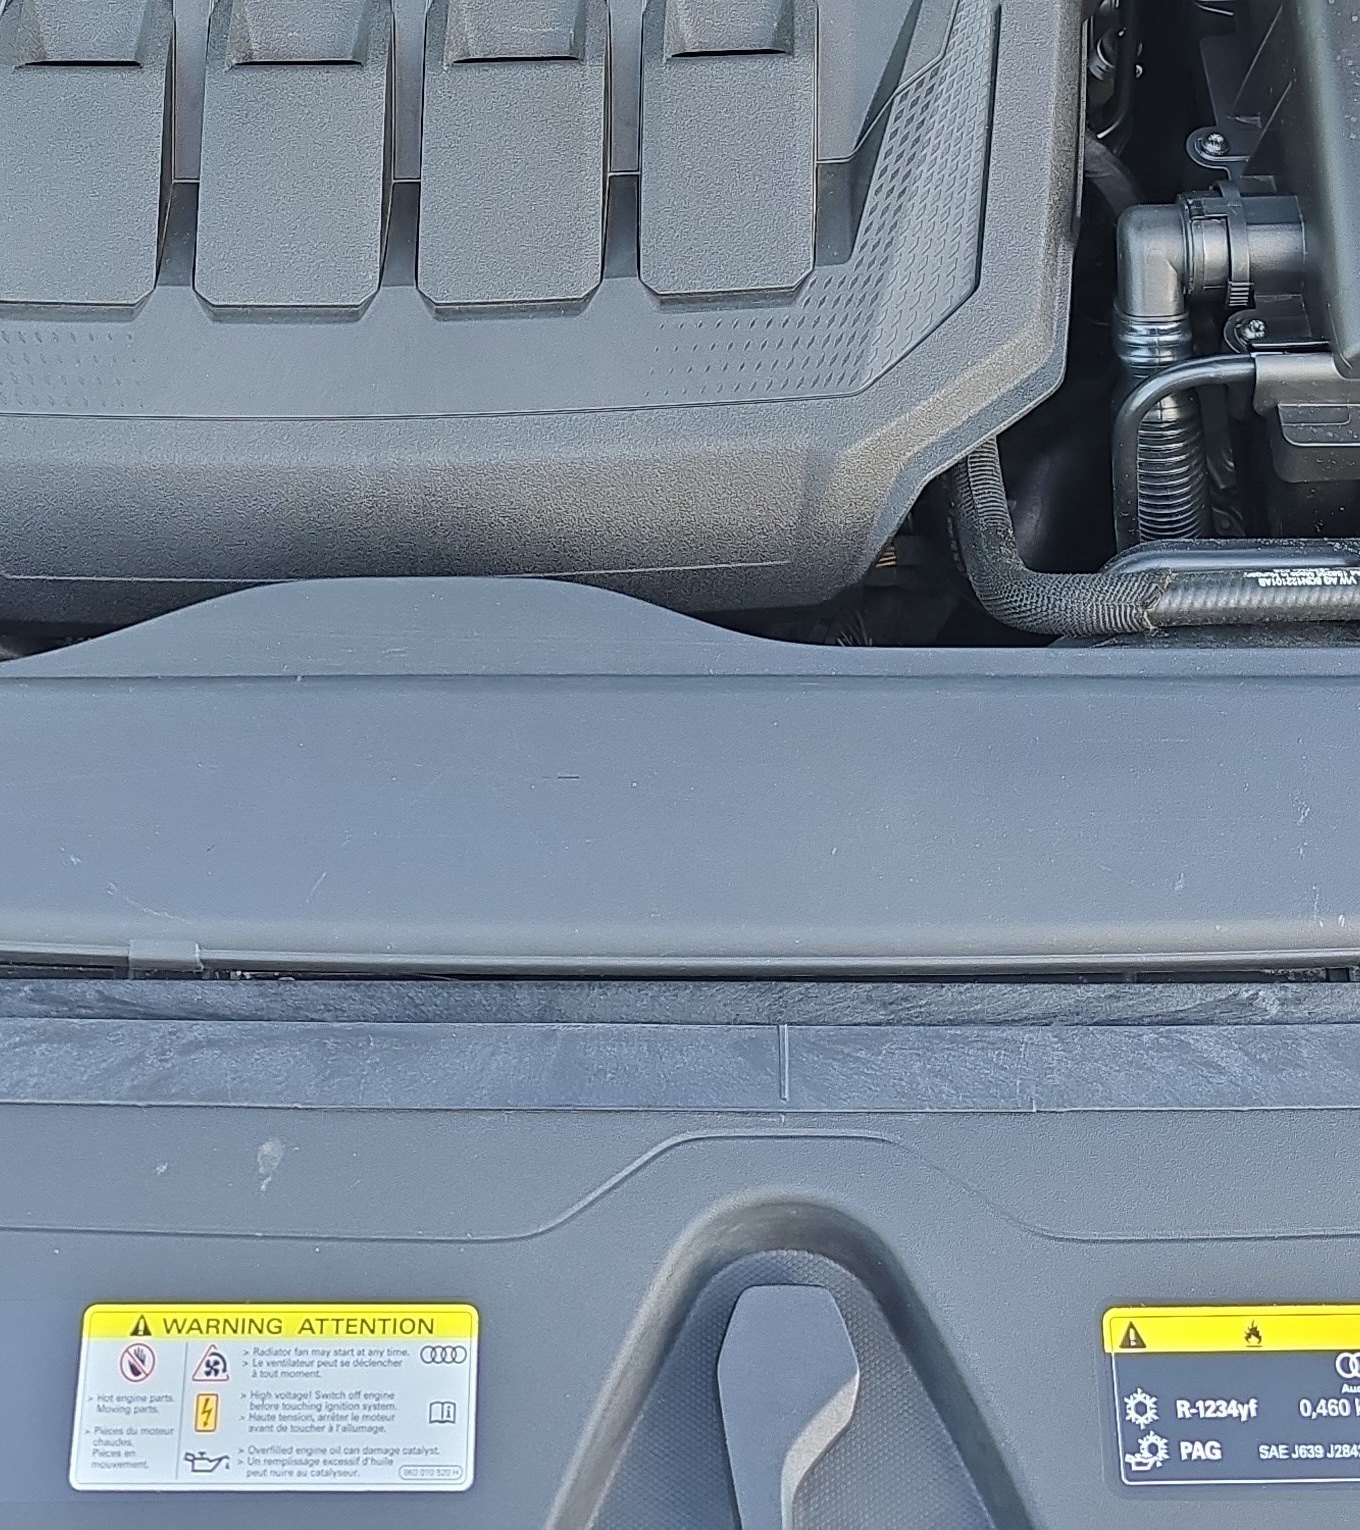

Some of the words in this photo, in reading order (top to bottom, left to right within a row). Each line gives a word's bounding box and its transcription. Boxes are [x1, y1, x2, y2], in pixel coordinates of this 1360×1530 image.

[163, 1318, 283, 1335] WARNING
[297, 1317, 434, 1334] ATTENTION
[253, 1348, 291, 1357] Radiator
[295, 1348, 309, 1356] fan
[312, 1349, 330, 1359] may
[334, 1348, 354, 1356] start
[357, 1348, 365, 1356] at
[368, 1349, 386, 1359] any
[389, 1348, 409, 1356] time.
[252, 1359, 263, 1367] Le
[266, 1359, 313, 1367] ventilateur
[317, 1360, 337, 1369] peut
[353, 1358, 402, 1367] déclencher
[260, 1370, 278, 1378] tout
[281, 1370, 321, 1378] moment.
[116, 1395, 147, 1404] engine
[150, 1395, 174, 1404] parts.
[250, 1391, 272, 1401] High
[274, 1391, 311, 1401] voltage!
[315, 1391, 346, 1400] Switch
[349, 1391, 360, 1400] off
[364, 1392, 395, 1401] engine
[97, 1406, 131, 1415] Moving
[134, 1406, 158, 1415] parts.
[250, 1402, 279, 1411] before
[282, 1402, 322, 1412] touching
[325, 1402, 360, 1412] ignition
[363, 1403, 397, 1412] system.
[1176, 1399, 1259, 1422] R-1234yf
[1299, 1399, 1351, 1420] 0,460
[249, 1413, 276, 1421] Haute
[318, 1413, 348, 1421] arrêter
[351, 1413, 359, 1421] le
[362, 1413, 395, 1421] moteur
[94, 1427, 124, 1435] Pièces
[126, 1427, 138, 1435] du
[248, 1424, 274, 1433] avant
[277, 1424, 287, 1433] de
[290, 1424, 325, 1433] toucher
[93, 1438, 133, 1446] chaudes.
[247, 1446, 293, 1455] Overfilled
[295, 1447, 327, 1456] engine
[330, 1446, 341, 1455] oil
[344, 1447, 360, 1455] can
[362, 1446, 400, 1456] damage
[402, 1446, 440, 1456] catalyst.
[1180, 1441, 1222, 1461] PAG
[1259, 1445, 1289, 1460] SAE
[1292, 1444, 1324, 1459] J639
[263, 1458, 320, 1467] remplissage
[323, 1457, 360, 1465] excessif
[246, 1469, 267, 1479] peut
[269, 1469, 294, 1477] nuire
[311, 1469, 360, 1478] catalyseur.
